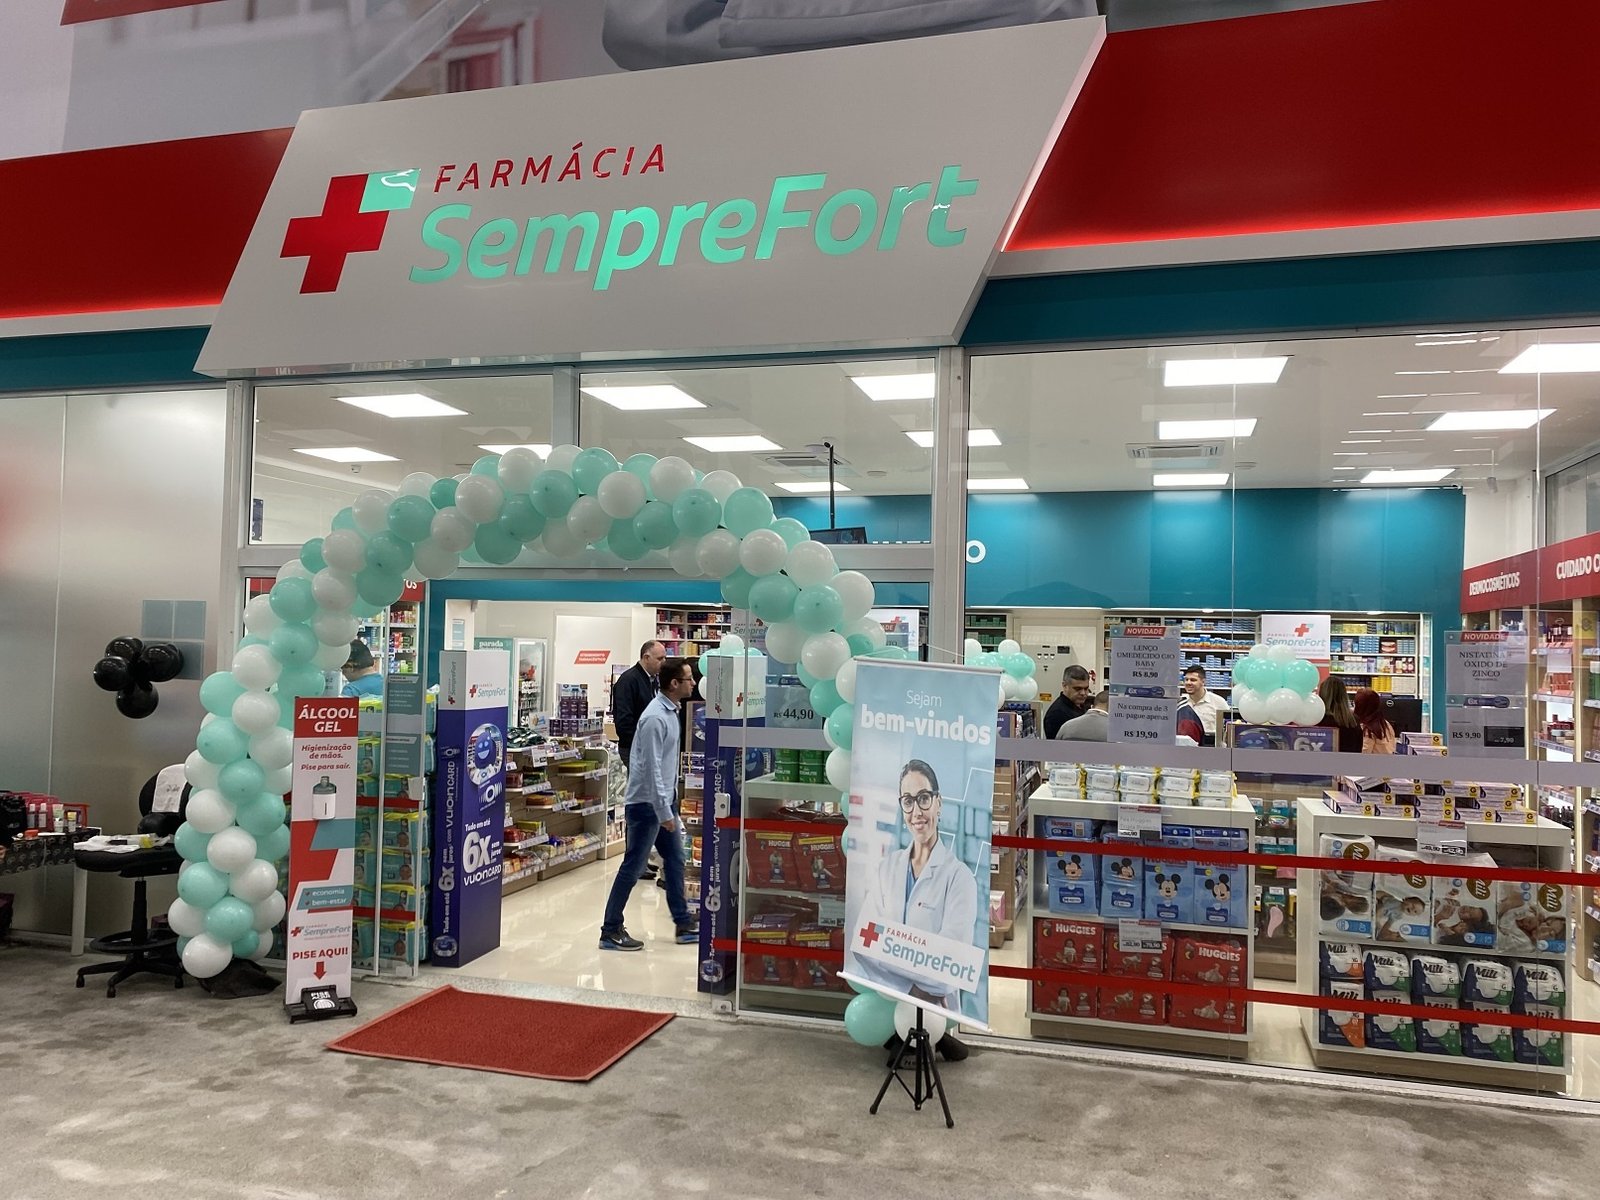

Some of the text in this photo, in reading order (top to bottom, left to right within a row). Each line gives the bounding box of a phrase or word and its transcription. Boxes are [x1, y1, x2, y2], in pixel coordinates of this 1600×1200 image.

[434, 140, 667, 193] FARMÁCIA
[409, 165, 979, 291] SempreFort
[1556, 555, 1592, 580] CUIDADO
[1469, 571, 1520, 596] DERMOCOSMÉTICOS
[1126, 627, 1163, 635] NOVIDADE
[1464, 632, 1505, 640] NOVIDADE
[479, 640, 504, 648] parada
[1133, 644, 1159, 653] LENÇO
[1116, 651, 1160, 659] UMEDECIDO
[1459, 650, 1506, 659] NISTATINA
[1463, 660, 1494, 668] ÓXIDO
[1472, 669, 1501, 677] ZINCO
[905, 689, 942, 709] Sejam
[298, 704, 357, 719] ÁLCOOL
[1117, 702, 1127, 710] Na
[1128, 704, 1153, 712] compra
[783, 707, 814, 721] 44,90
[1126, 713, 1145, 721] pague
[1145, 713, 1169, 721] apenas
[314, 721, 342, 733] GEL
[860, 703, 991, 746] bem-vindos
[1124, 730, 1159, 739] R$ 19,90
[1465, 731, 1481, 739] 9,90
[301, 743, 352, 753] Higienização
[320, 751, 343, 759] mãos.
[301, 763, 317, 771] Pise
[317, 764, 335, 772] para
[312, 888, 345, 896] economia
[311, 897, 347, 906] bem-estar
[303, 925, 351, 937] SempreFort
[1056, 923, 1096, 936] HUGGIES
[886, 927, 927, 946] FARMÁCIA
[292, 946, 348, 960] PISE AQUI!
[1198, 946, 1241, 962] HUGGIES
[1327, 943, 1348, 954] Mili
[882, 936, 976, 982] SempreFort
[1373, 954, 1395, 967] Mili
[1423, 962, 1443, 974] Mili
[1476, 966, 1498, 979] Mili
